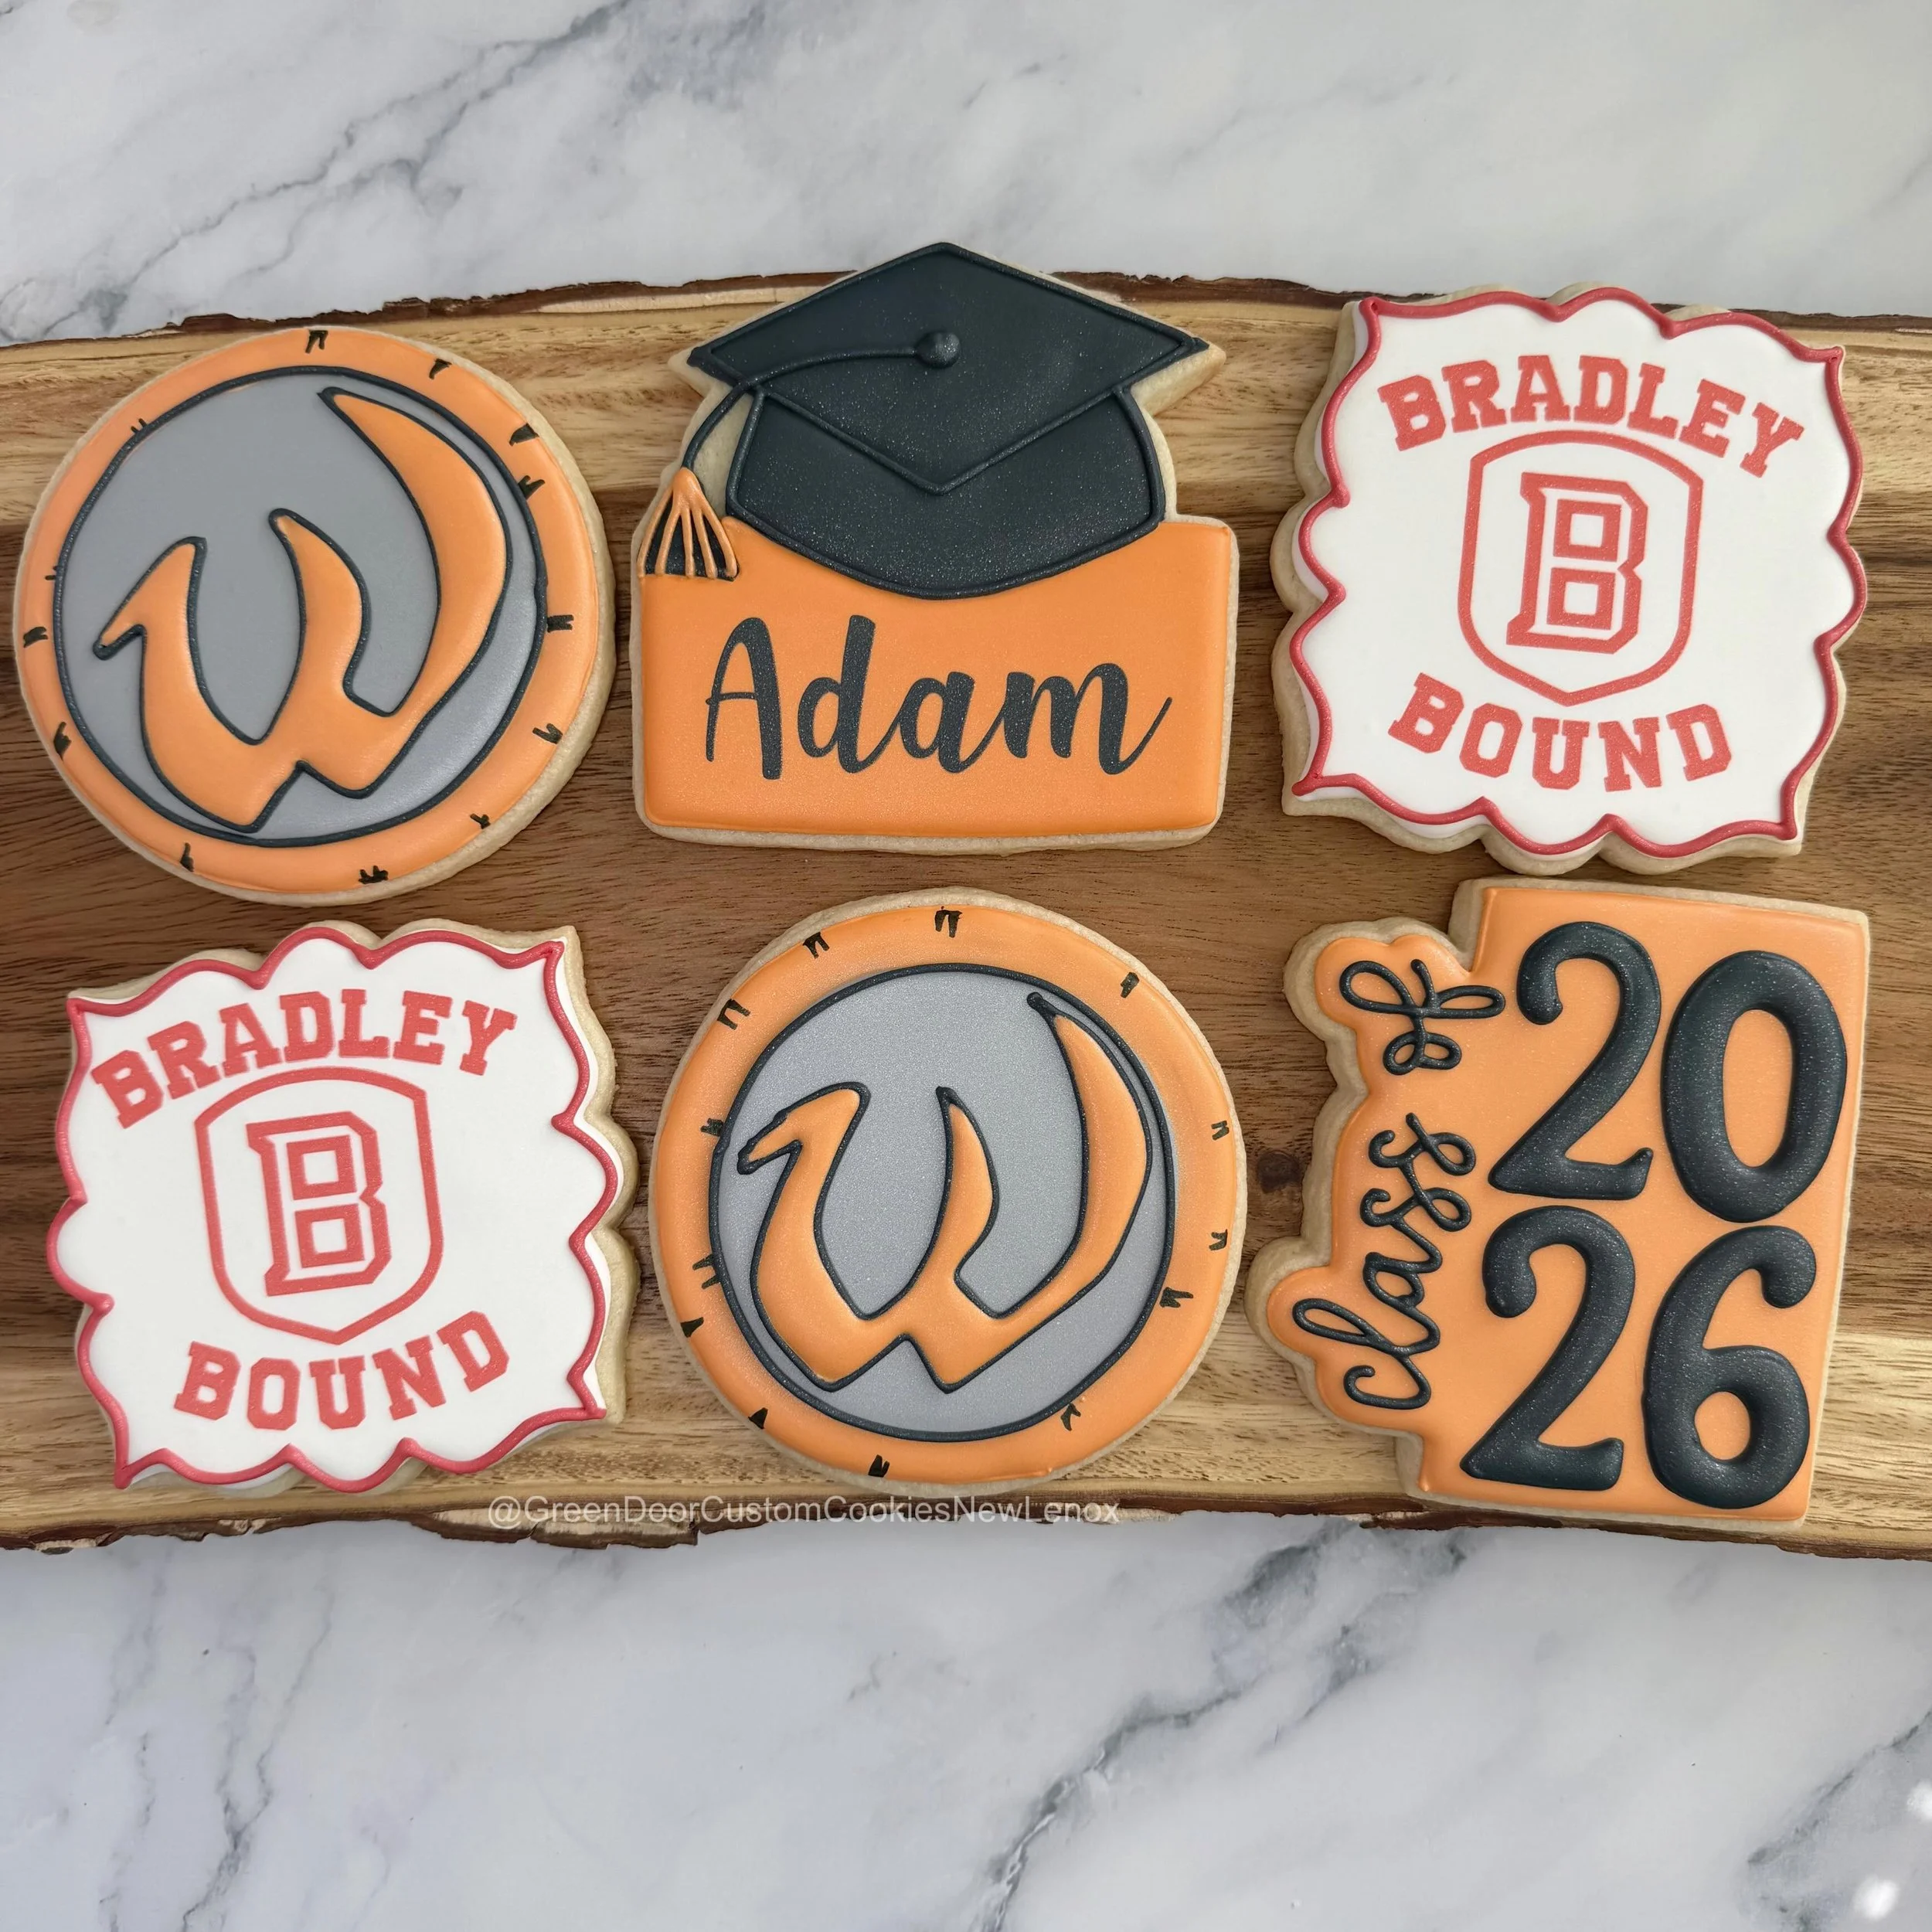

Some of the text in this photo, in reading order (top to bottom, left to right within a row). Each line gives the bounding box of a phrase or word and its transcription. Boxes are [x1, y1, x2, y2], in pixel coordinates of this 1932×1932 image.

[1377, 354, 1805, 478] BRADLEY
[1506, 471, 1648, 654] B
[704, 614, 1173, 781] Adam
[1388, 672, 1733, 793] BOUND
[90, 988, 517, 1129] BRADLEY
[1339, 958, 1506, 1076] of
[1487, 920, 1848, 1224] 20
[246, 1111, 392, 1298] B
[174, 1310, 510, 1431] BOUND
[1459, 1205, 1818, 1510] 26
